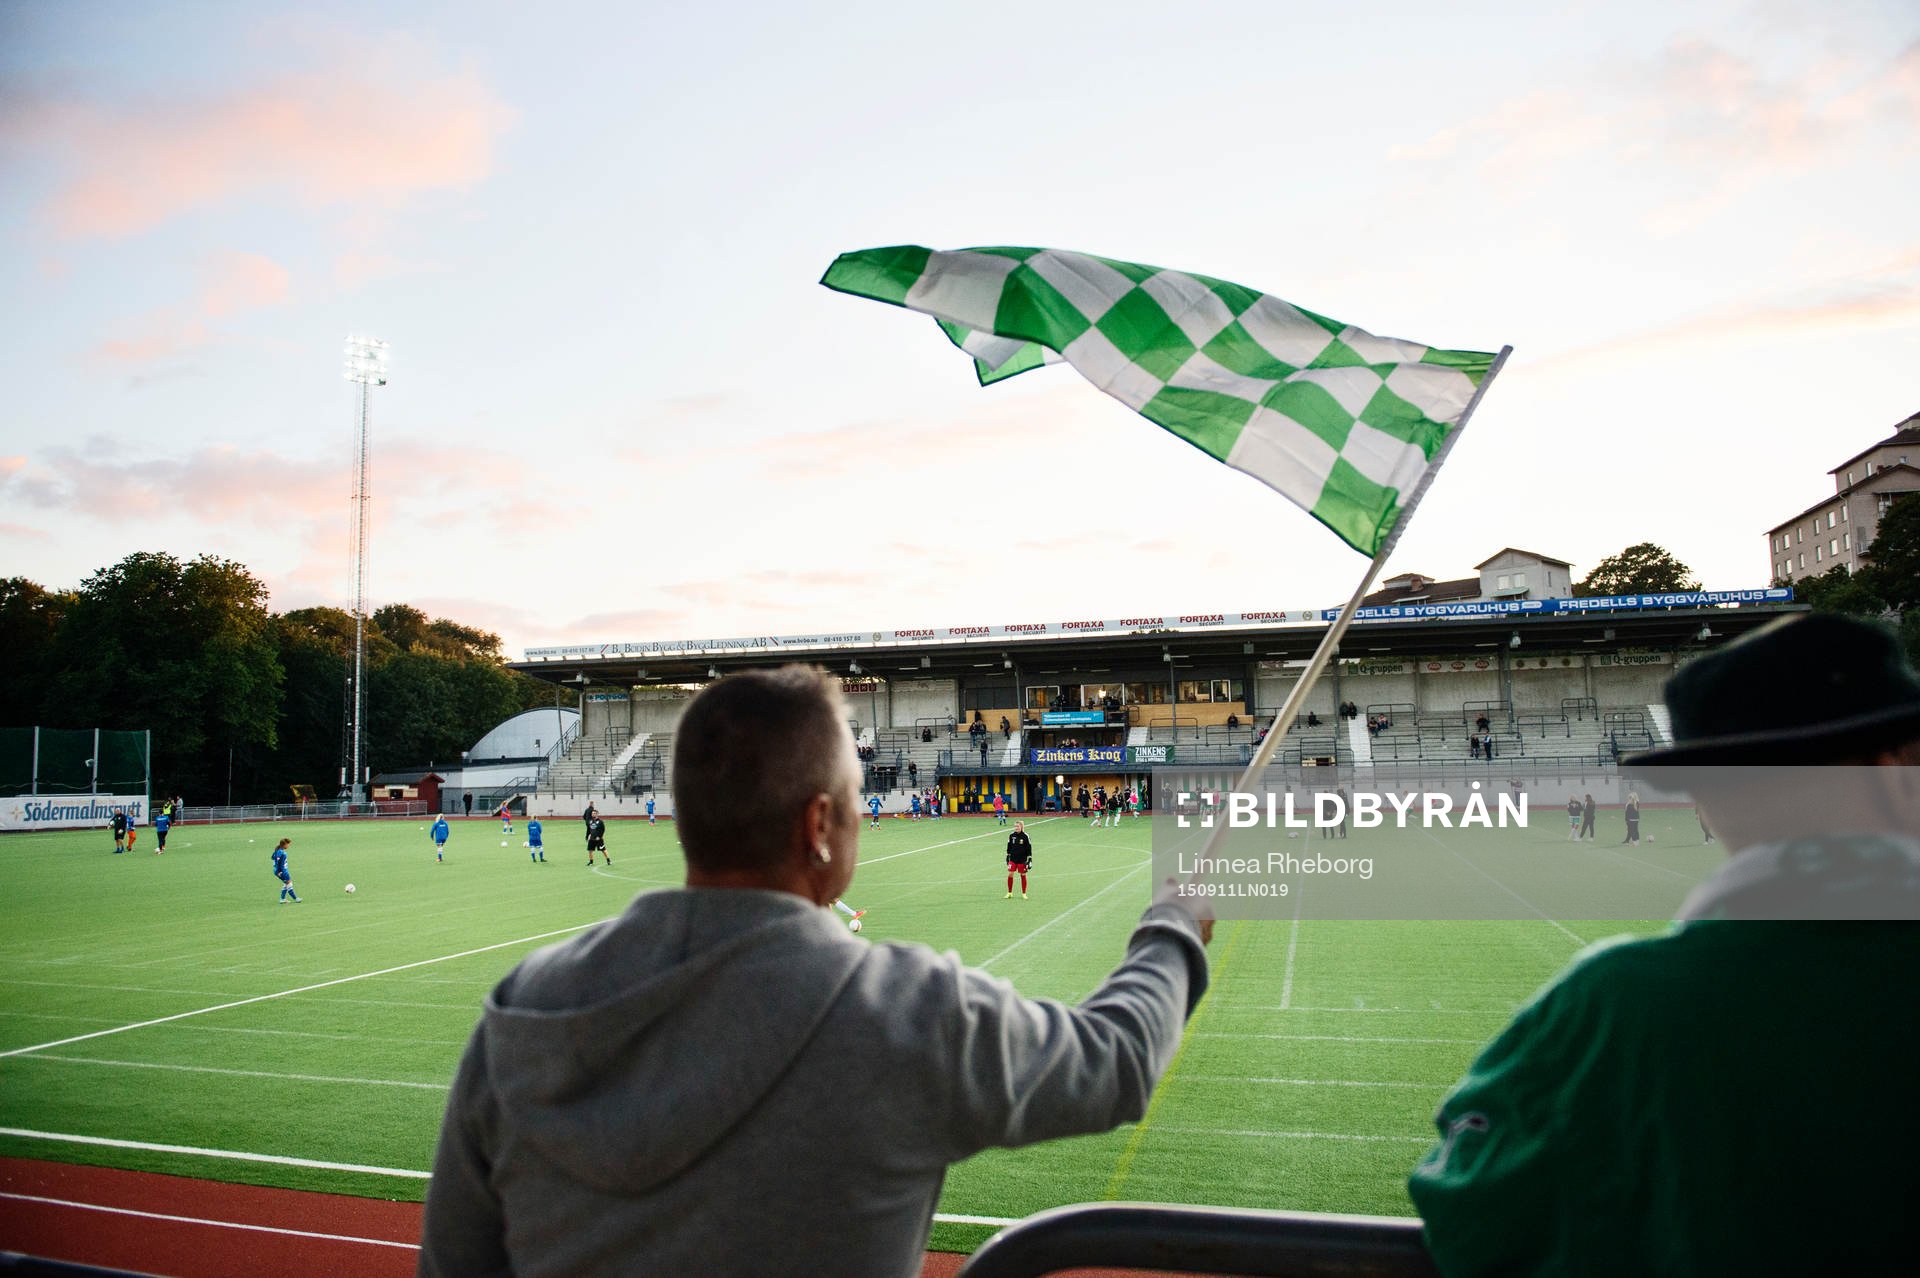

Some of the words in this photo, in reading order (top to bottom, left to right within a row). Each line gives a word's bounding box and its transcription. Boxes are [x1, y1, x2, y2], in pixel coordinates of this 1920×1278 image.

[1559, 597, 1637, 610] FREDELLS
[1642, 590, 1765, 606] BYGGVARUHUS
[1240, 611, 1287, 621] FORTAXA
[1327, 607, 1400, 620] FDELLS
[1404, 602, 1520, 616] BYGGVARUHUS
[1120, 617, 1164, 626] FORTAXA
[1179, 614, 1225, 624] FORTAXA
[1004, 623, 1046, 632] FORTAXA
[1061, 620, 1105, 630] FORTAXA
[894, 629, 935, 638] FORTAXA
[949, 626, 990, 635] FORTAXA
[612, 644, 620, 653] B.
[676, 641, 686, 650] &
[750, 637, 767, 647] AB
[1613, 655, 1661, 665] Q-gruppen
[1036, 749, 1084, 762] Zinkens
[1087, 748, 1121, 761] Krog
[1135, 746, 1167, 756] ZINKENS
